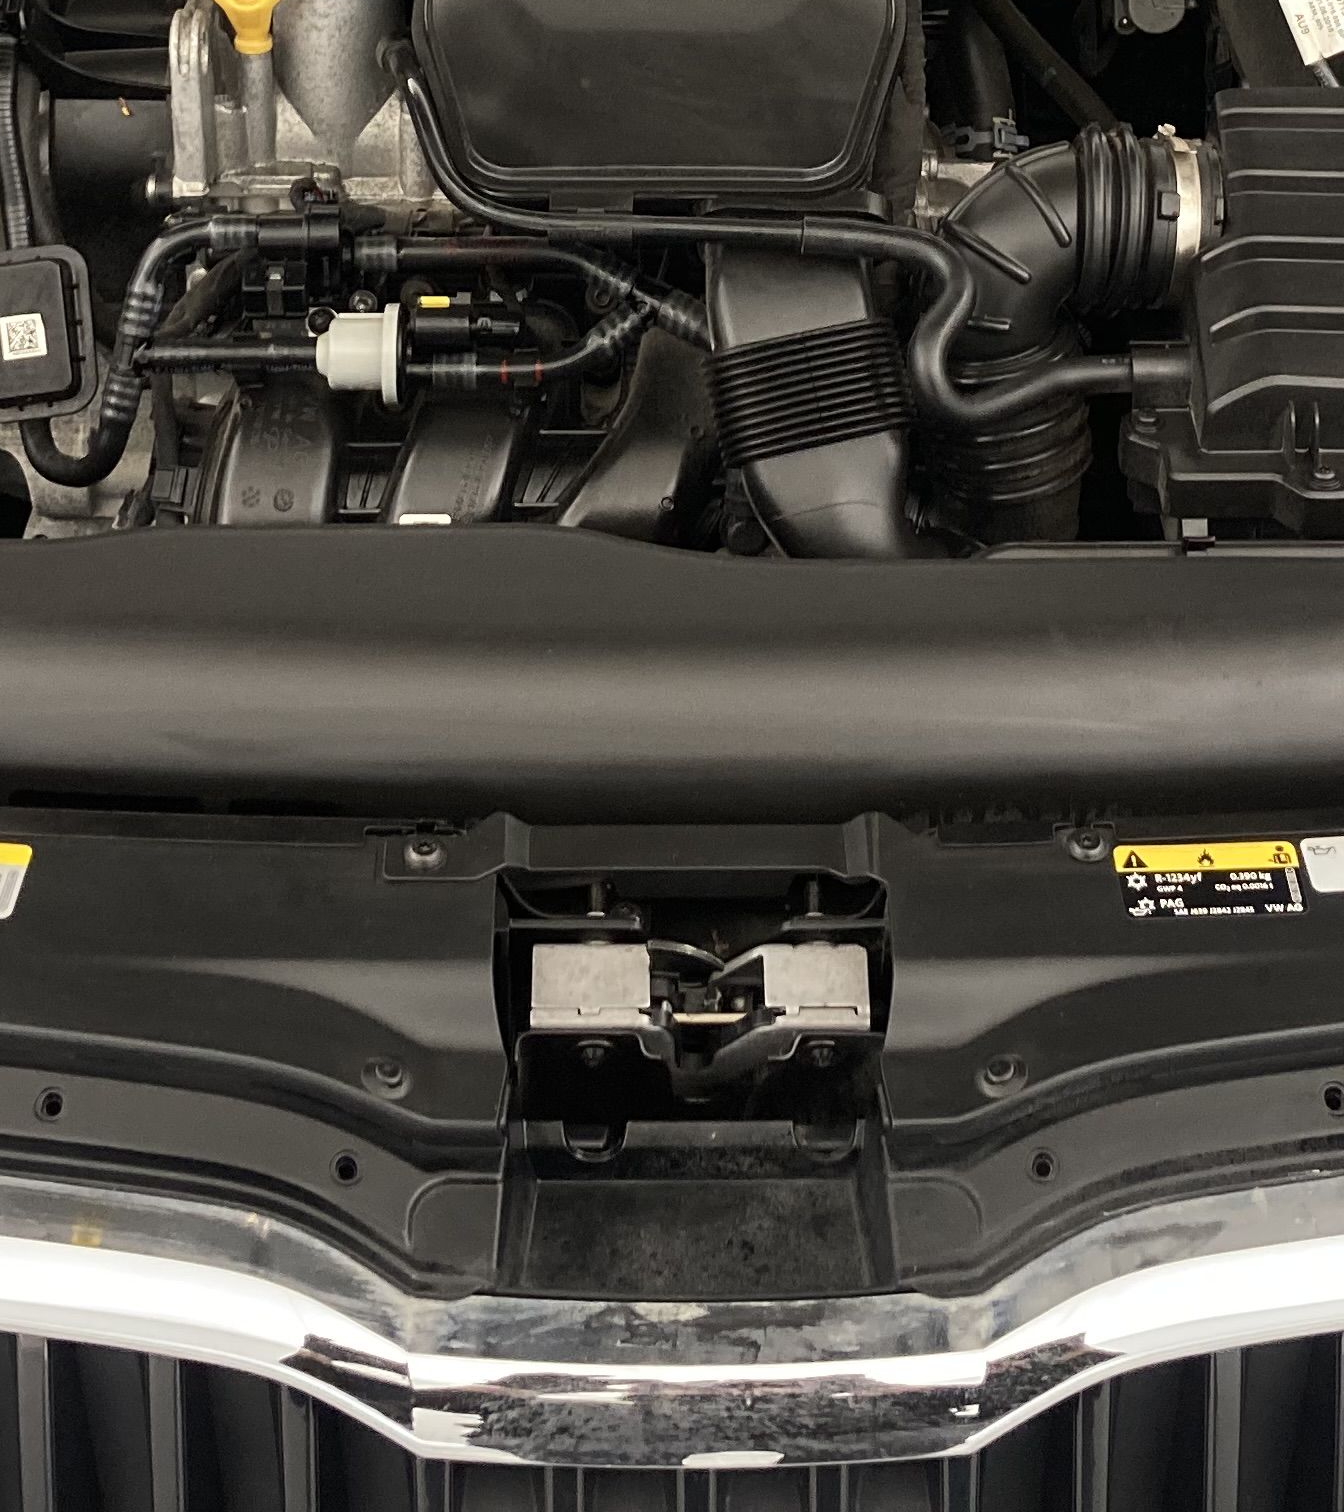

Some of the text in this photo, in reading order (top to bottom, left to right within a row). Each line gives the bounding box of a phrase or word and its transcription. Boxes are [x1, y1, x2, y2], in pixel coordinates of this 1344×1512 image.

[1295, 14, 1310, 35] AU9
[1154, 872, 1202, 884] R-1234yf
[1258, 871, 1272, 881] kg
[1159, 898, 1184, 908] PAG
[1265, 902, 1304, 912] VW AG
